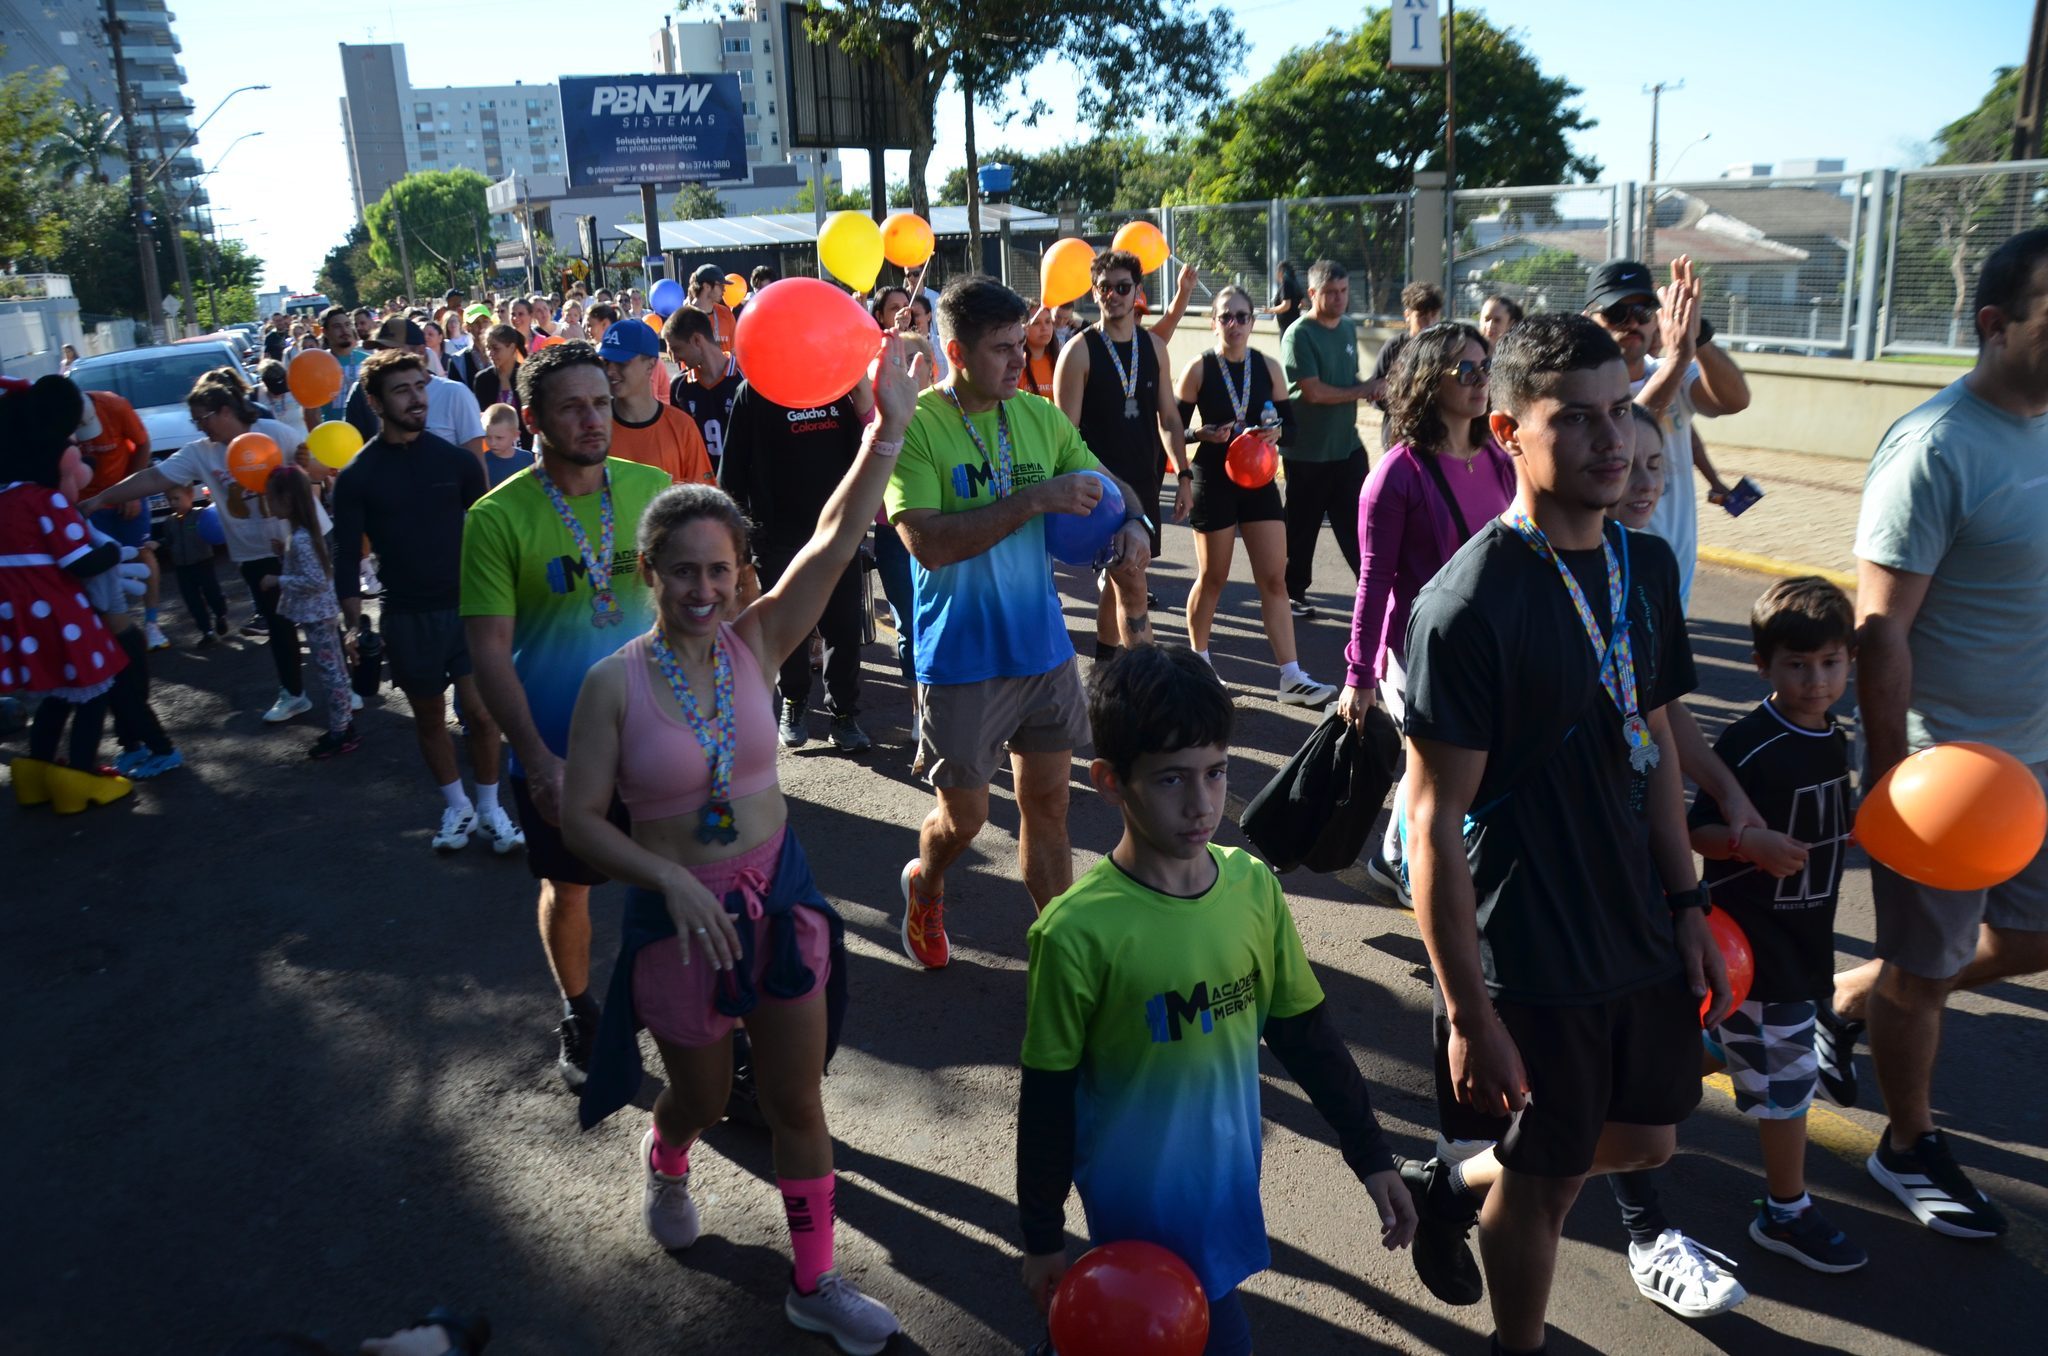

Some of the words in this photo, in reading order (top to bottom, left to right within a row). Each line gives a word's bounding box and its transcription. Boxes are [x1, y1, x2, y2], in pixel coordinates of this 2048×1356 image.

[591, 83, 713, 116] PBNEW
[622, 114, 715, 128] SISTEMAS
[615, 136, 649, 146] Soluções
[650, 134, 697, 144] tecnológicas
[629, 144, 661, 153] produtos
[668, 143, 698, 151] serviços.
[787, 408, 827, 421] Gaúcho
[830, 406, 840, 417] &
[791, 419, 840, 434] Colorado.
[704, 419, 722, 456] 9
[1164, 980, 1214, 1042] M
